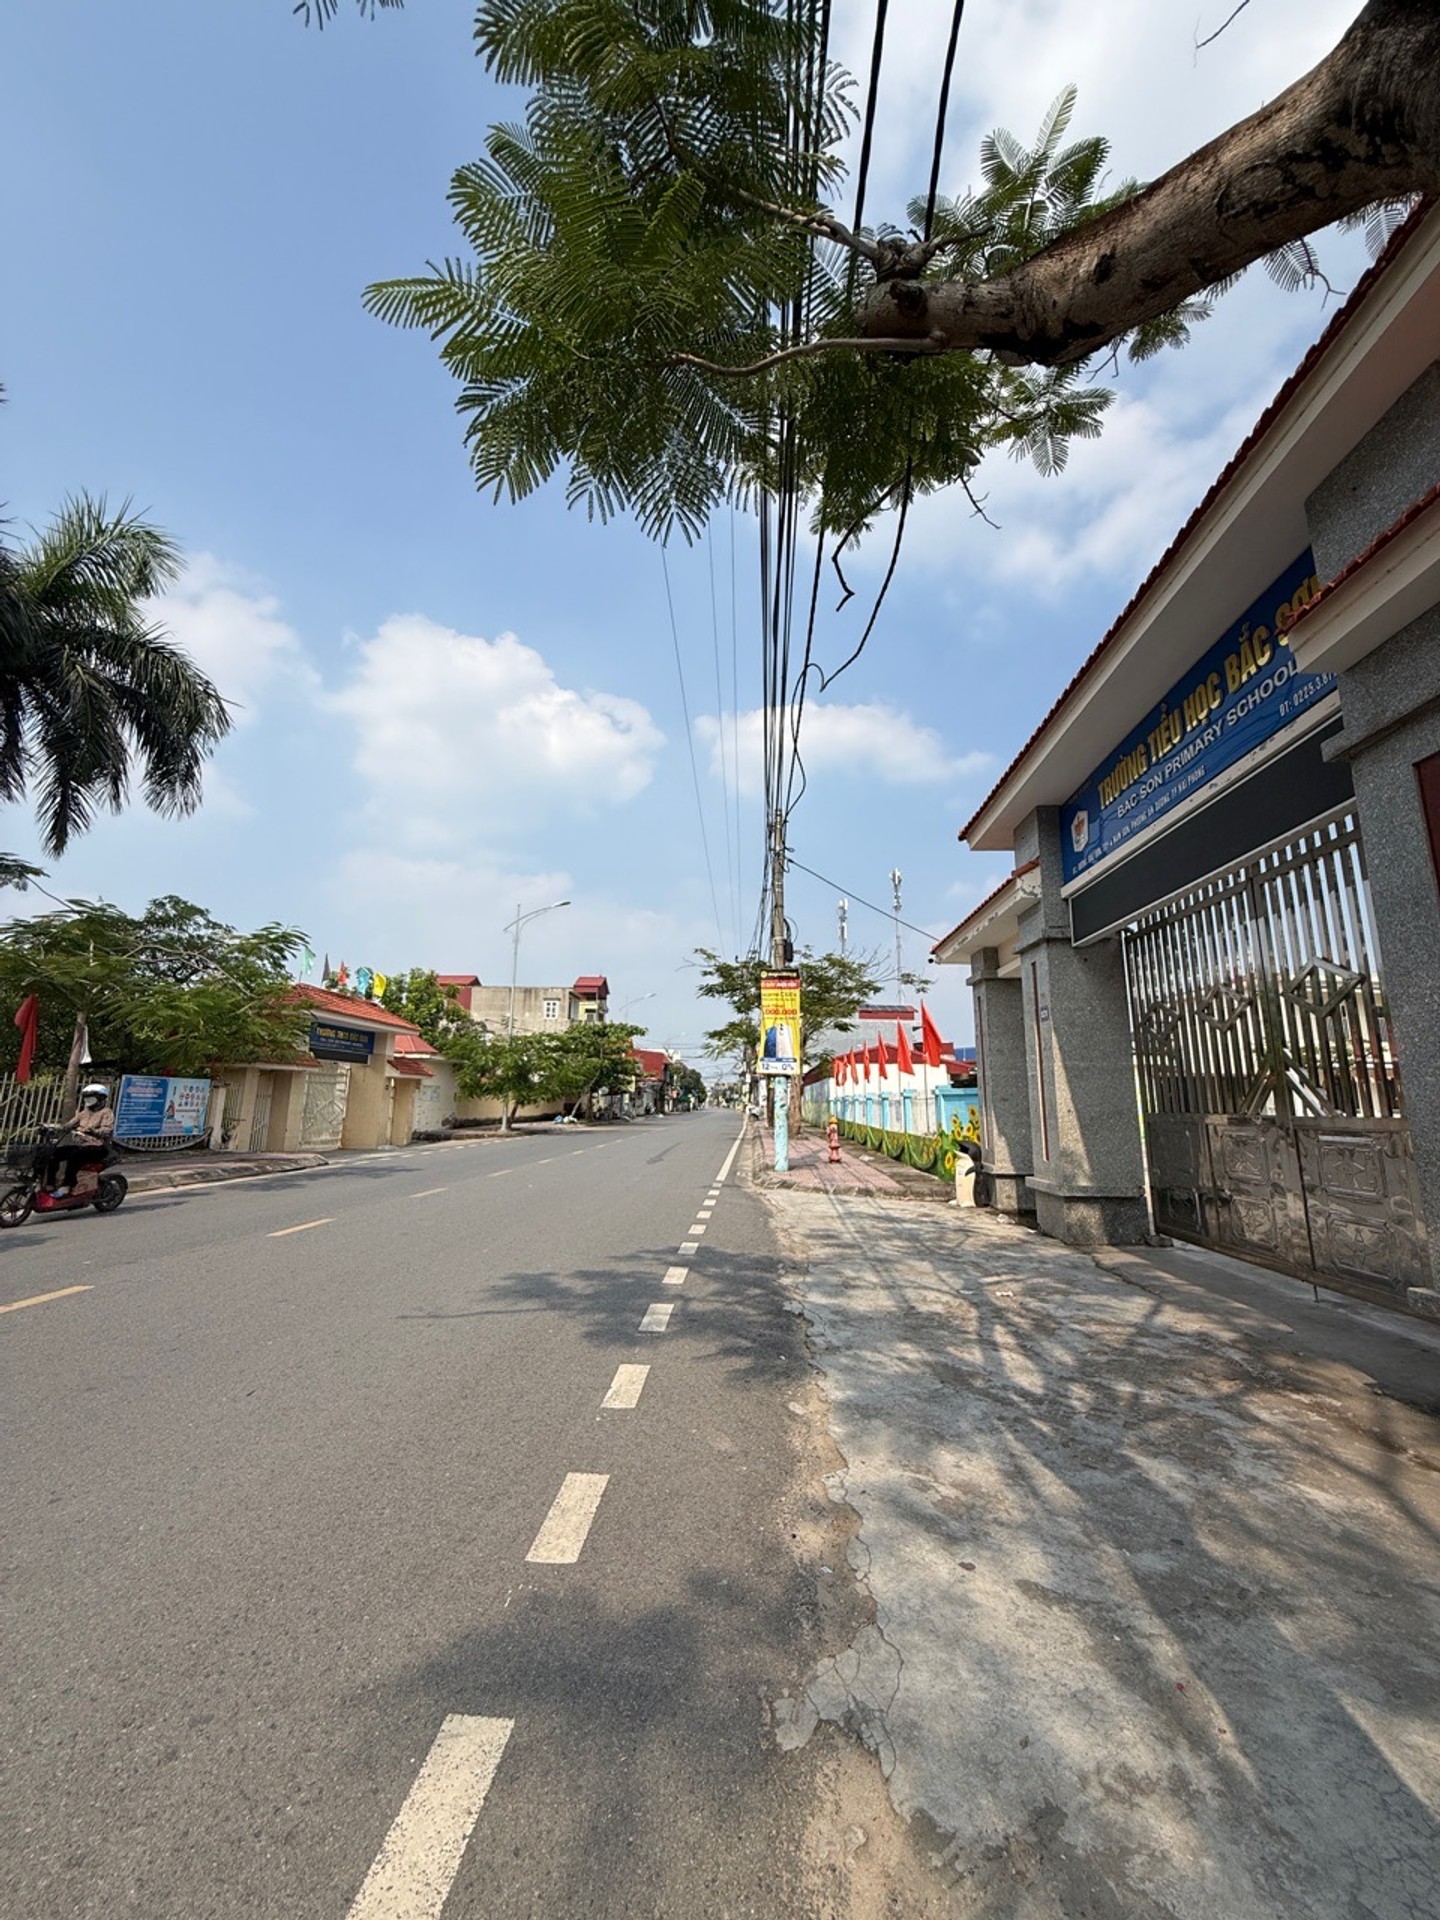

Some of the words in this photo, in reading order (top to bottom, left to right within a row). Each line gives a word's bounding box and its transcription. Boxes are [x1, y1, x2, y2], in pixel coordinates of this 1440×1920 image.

[1098, 743, 1148, 810] TRƯỜNG
[1148, 703, 1182, 764] TIỂU
[1183, 672, 1223, 733] HỌC
[1224, 622, 1272, 695] BẮC
[1117, 793, 1139, 819] BAC
[1139, 771, 1163, 799] SON
[1165, 719, 1223, 779] PRIMARY
[1226, 660, 1300, 726] SCHOOL
